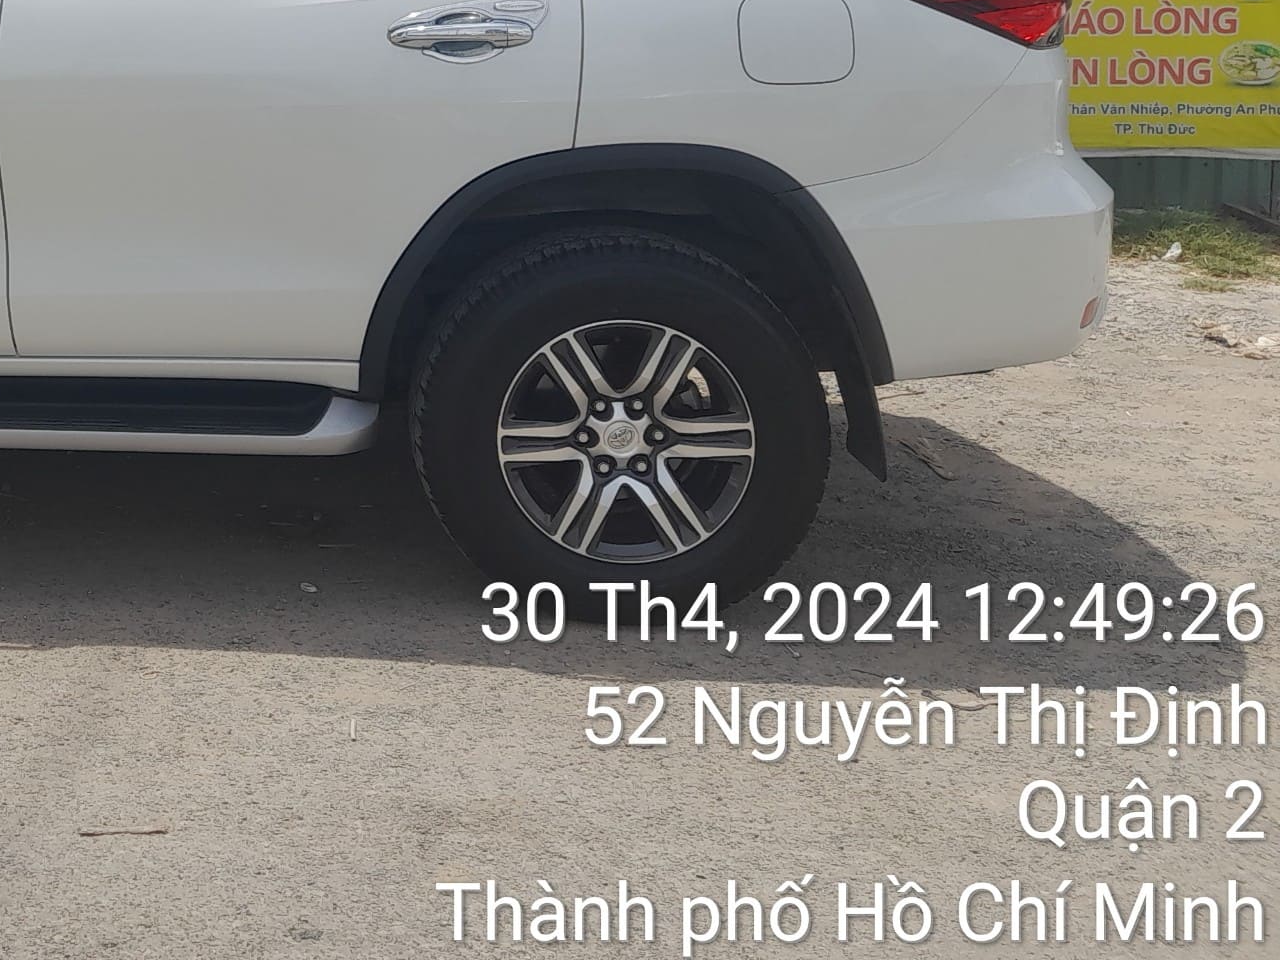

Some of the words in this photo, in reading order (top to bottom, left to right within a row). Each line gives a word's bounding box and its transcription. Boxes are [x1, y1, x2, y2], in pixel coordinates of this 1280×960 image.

[1064, 0, 1125, 35] ÁO
[1135, 0, 1238, 35] LÒNG
[1071, 58, 1098, 85] N
[1109, 50, 1211, 86] LÒNG
[1068, 103, 1096, 115] hân
[1235, 103, 1255, 115] An
[1114, 123, 1134, 135] TP.
